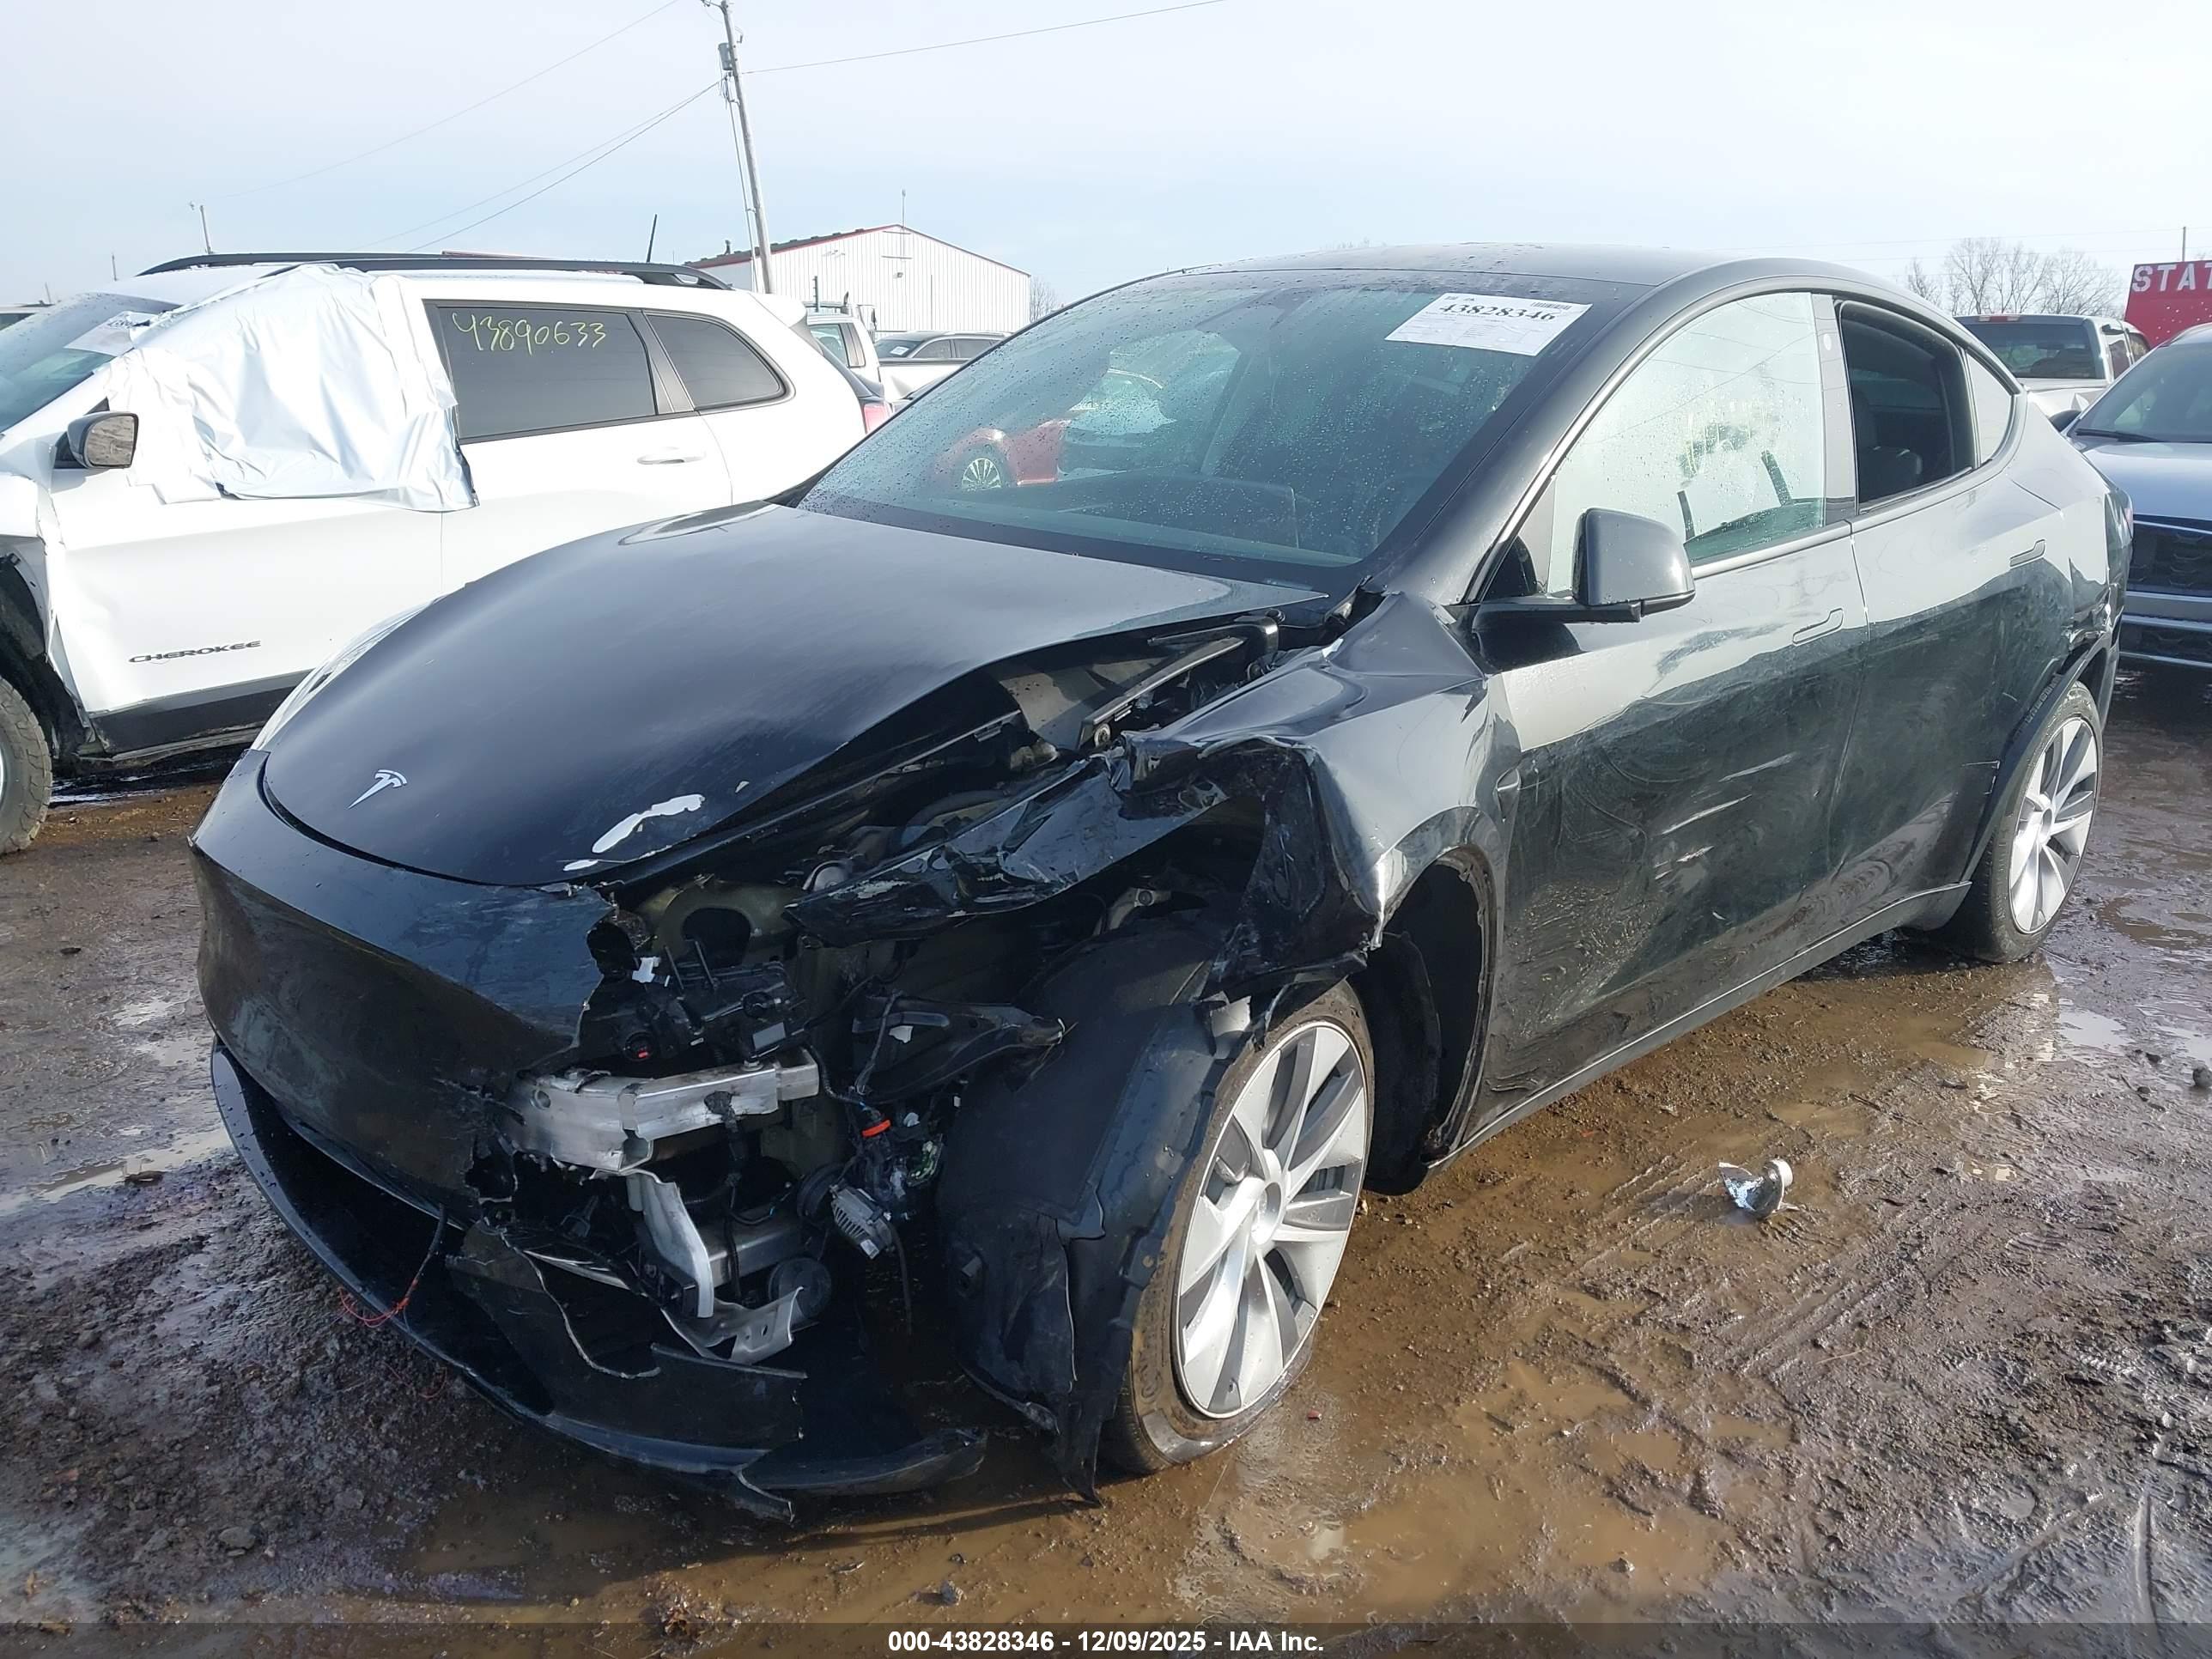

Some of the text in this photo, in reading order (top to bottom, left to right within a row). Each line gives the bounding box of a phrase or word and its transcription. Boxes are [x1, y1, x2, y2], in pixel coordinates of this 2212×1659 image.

[1439, 303, 1556, 320] 43828346
[452, 312, 606, 356] 43890633
[129, 640, 261, 663] CHEROKEE
